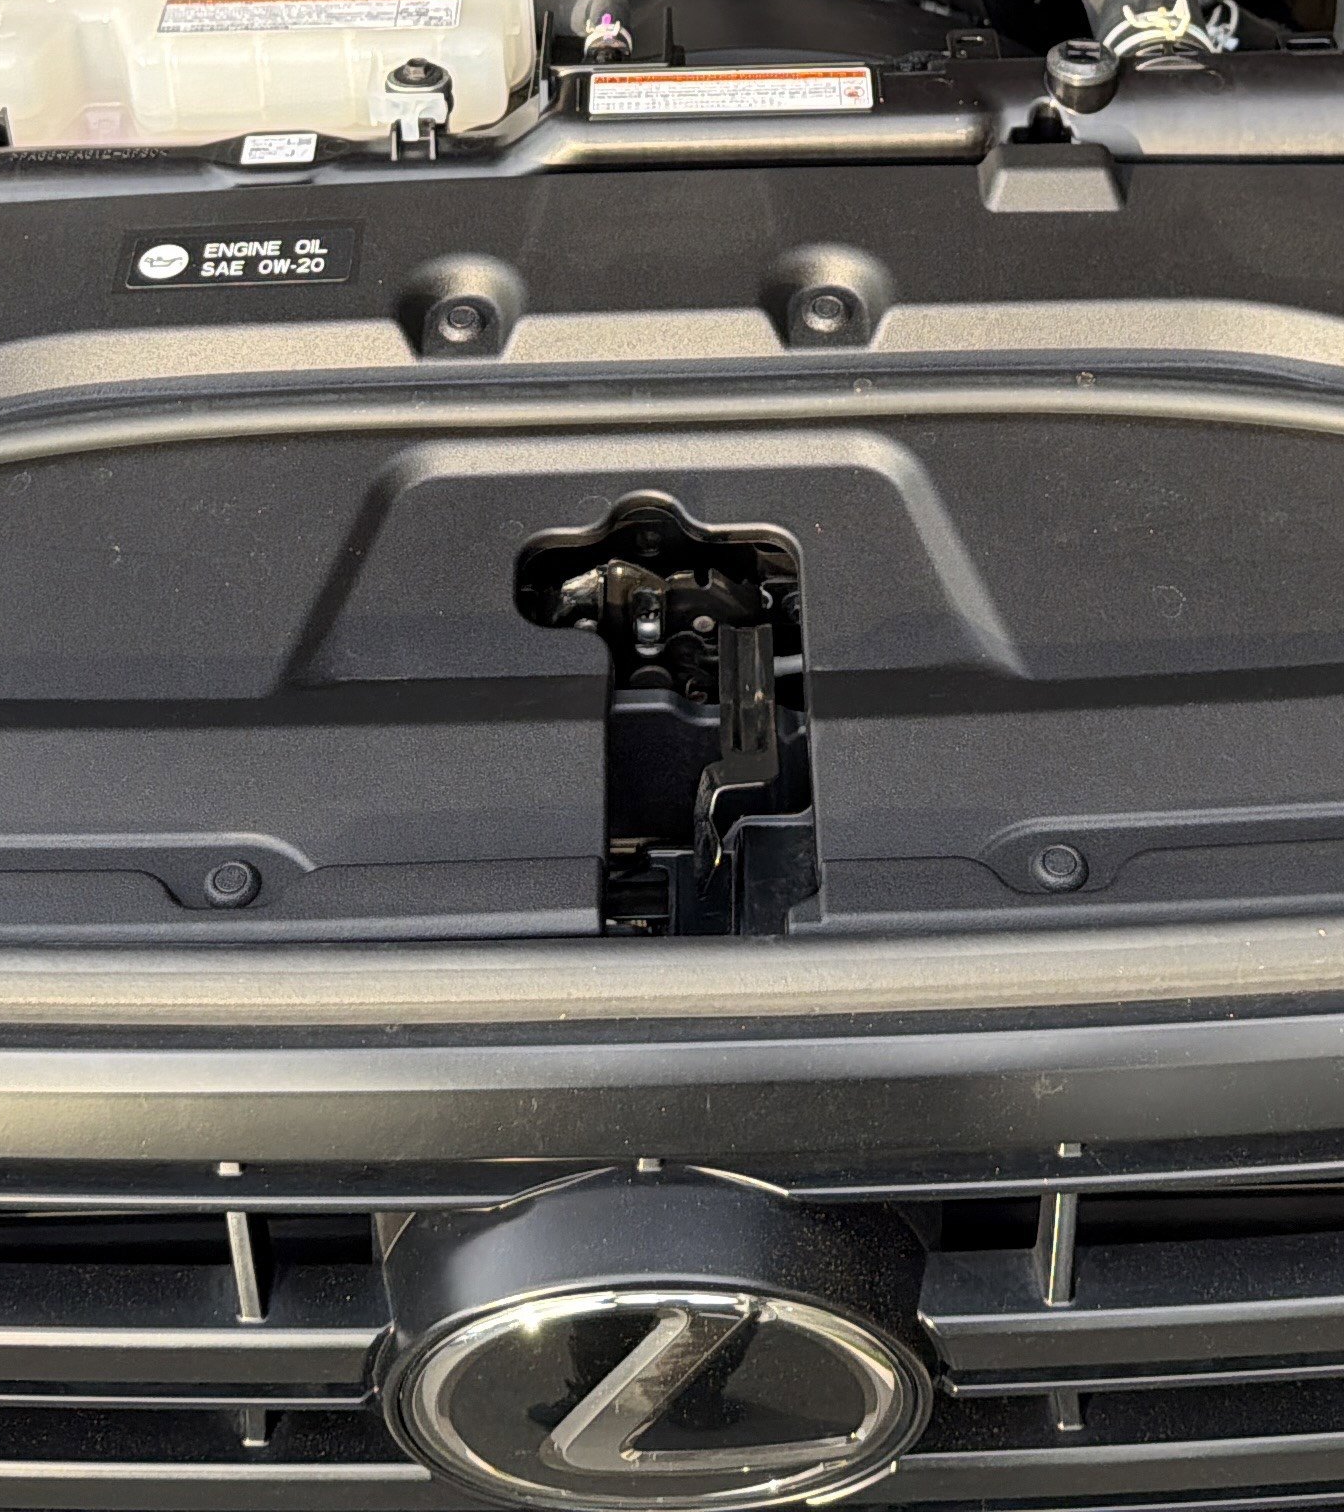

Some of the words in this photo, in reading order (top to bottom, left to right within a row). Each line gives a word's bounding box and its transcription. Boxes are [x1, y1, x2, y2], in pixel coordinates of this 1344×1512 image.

[203, 240, 283, 258] ENGINE
[294, 239, 329, 255] OIL
[200, 260, 246, 277] SAE
[258, 257, 326, 275] 0W-20
